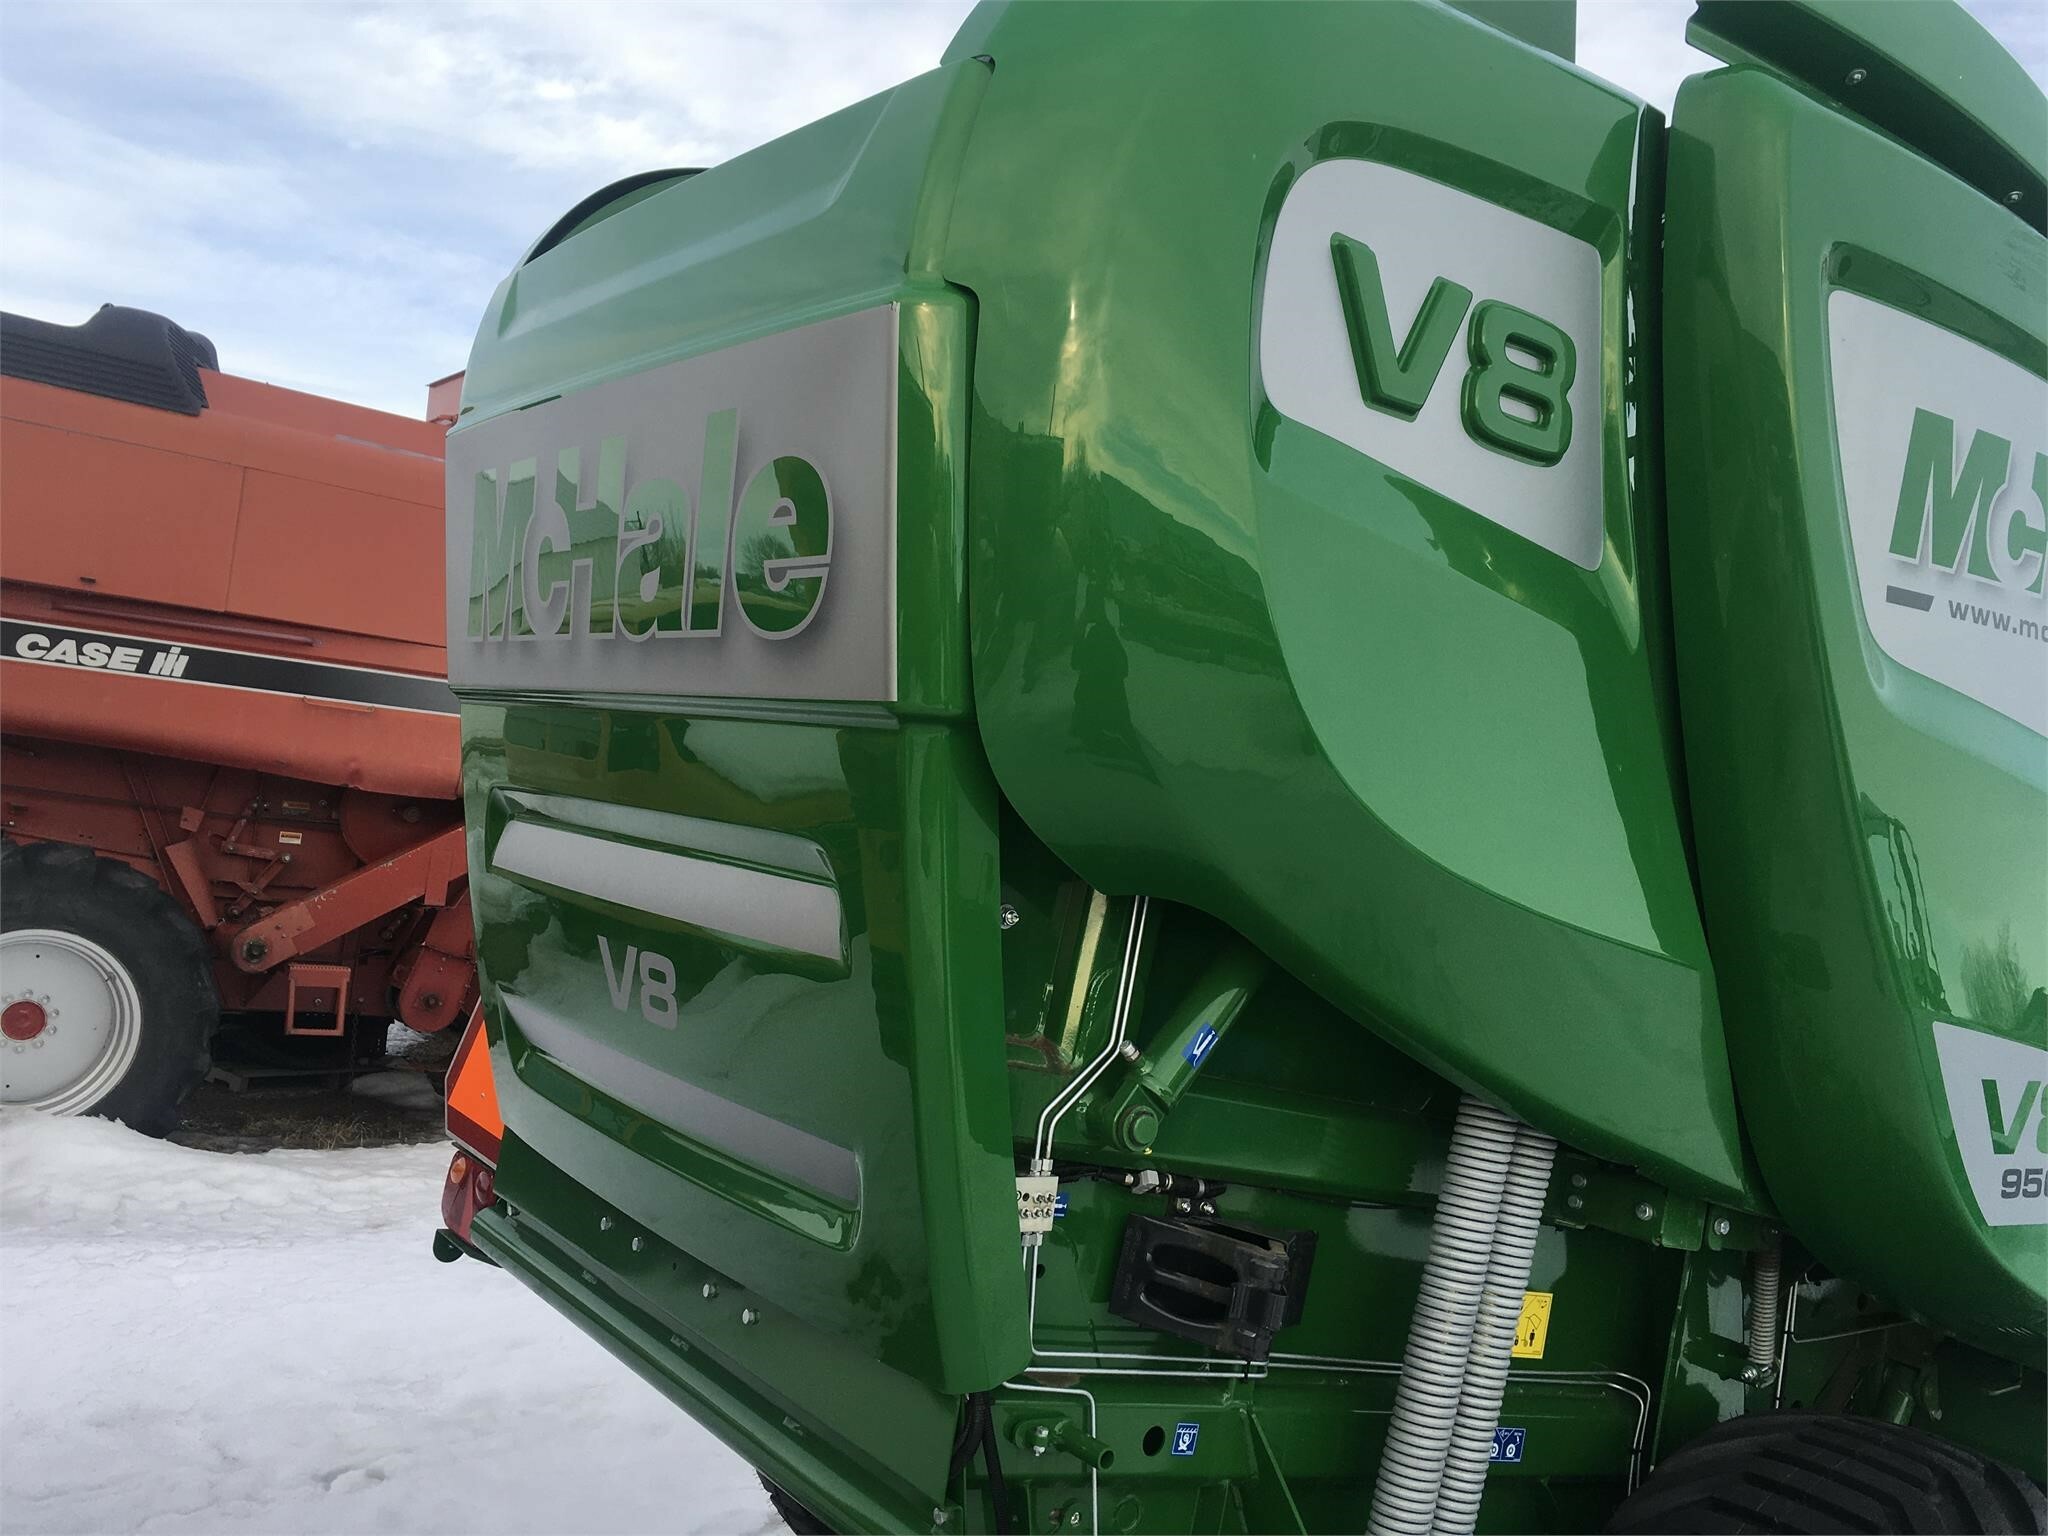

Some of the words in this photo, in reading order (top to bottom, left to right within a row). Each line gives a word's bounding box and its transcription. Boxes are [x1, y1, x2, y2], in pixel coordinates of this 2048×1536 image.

[1330, 231, 1577, 468] V8
[467, 407, 834, 642] McHale
[15, 633, 144, 671] CASE
[597, 934, 678, 1031] V8
[2000, 1168, 2048, 1199] 95
